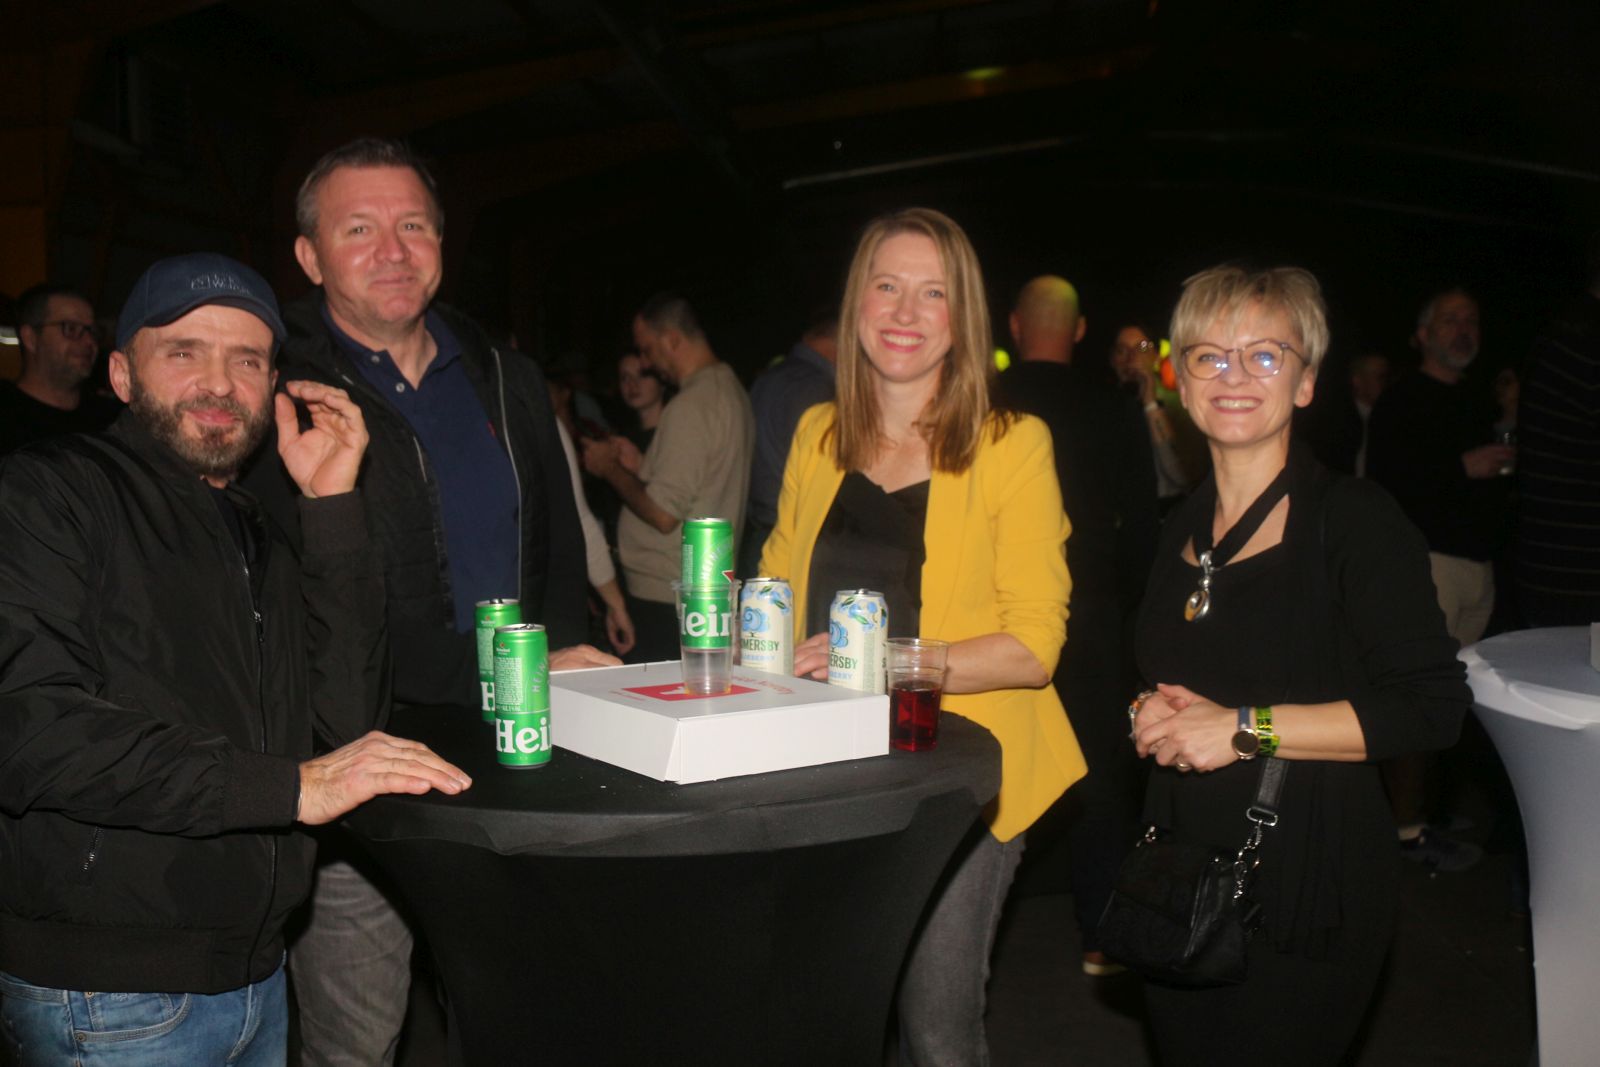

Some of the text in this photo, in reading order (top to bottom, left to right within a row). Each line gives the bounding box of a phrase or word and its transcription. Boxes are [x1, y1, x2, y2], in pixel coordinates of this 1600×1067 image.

[741, 639, 779, 651] MERSBY
[830, 655, 857, 670] ERSBY
[496, 717, 551, 753] Hei
